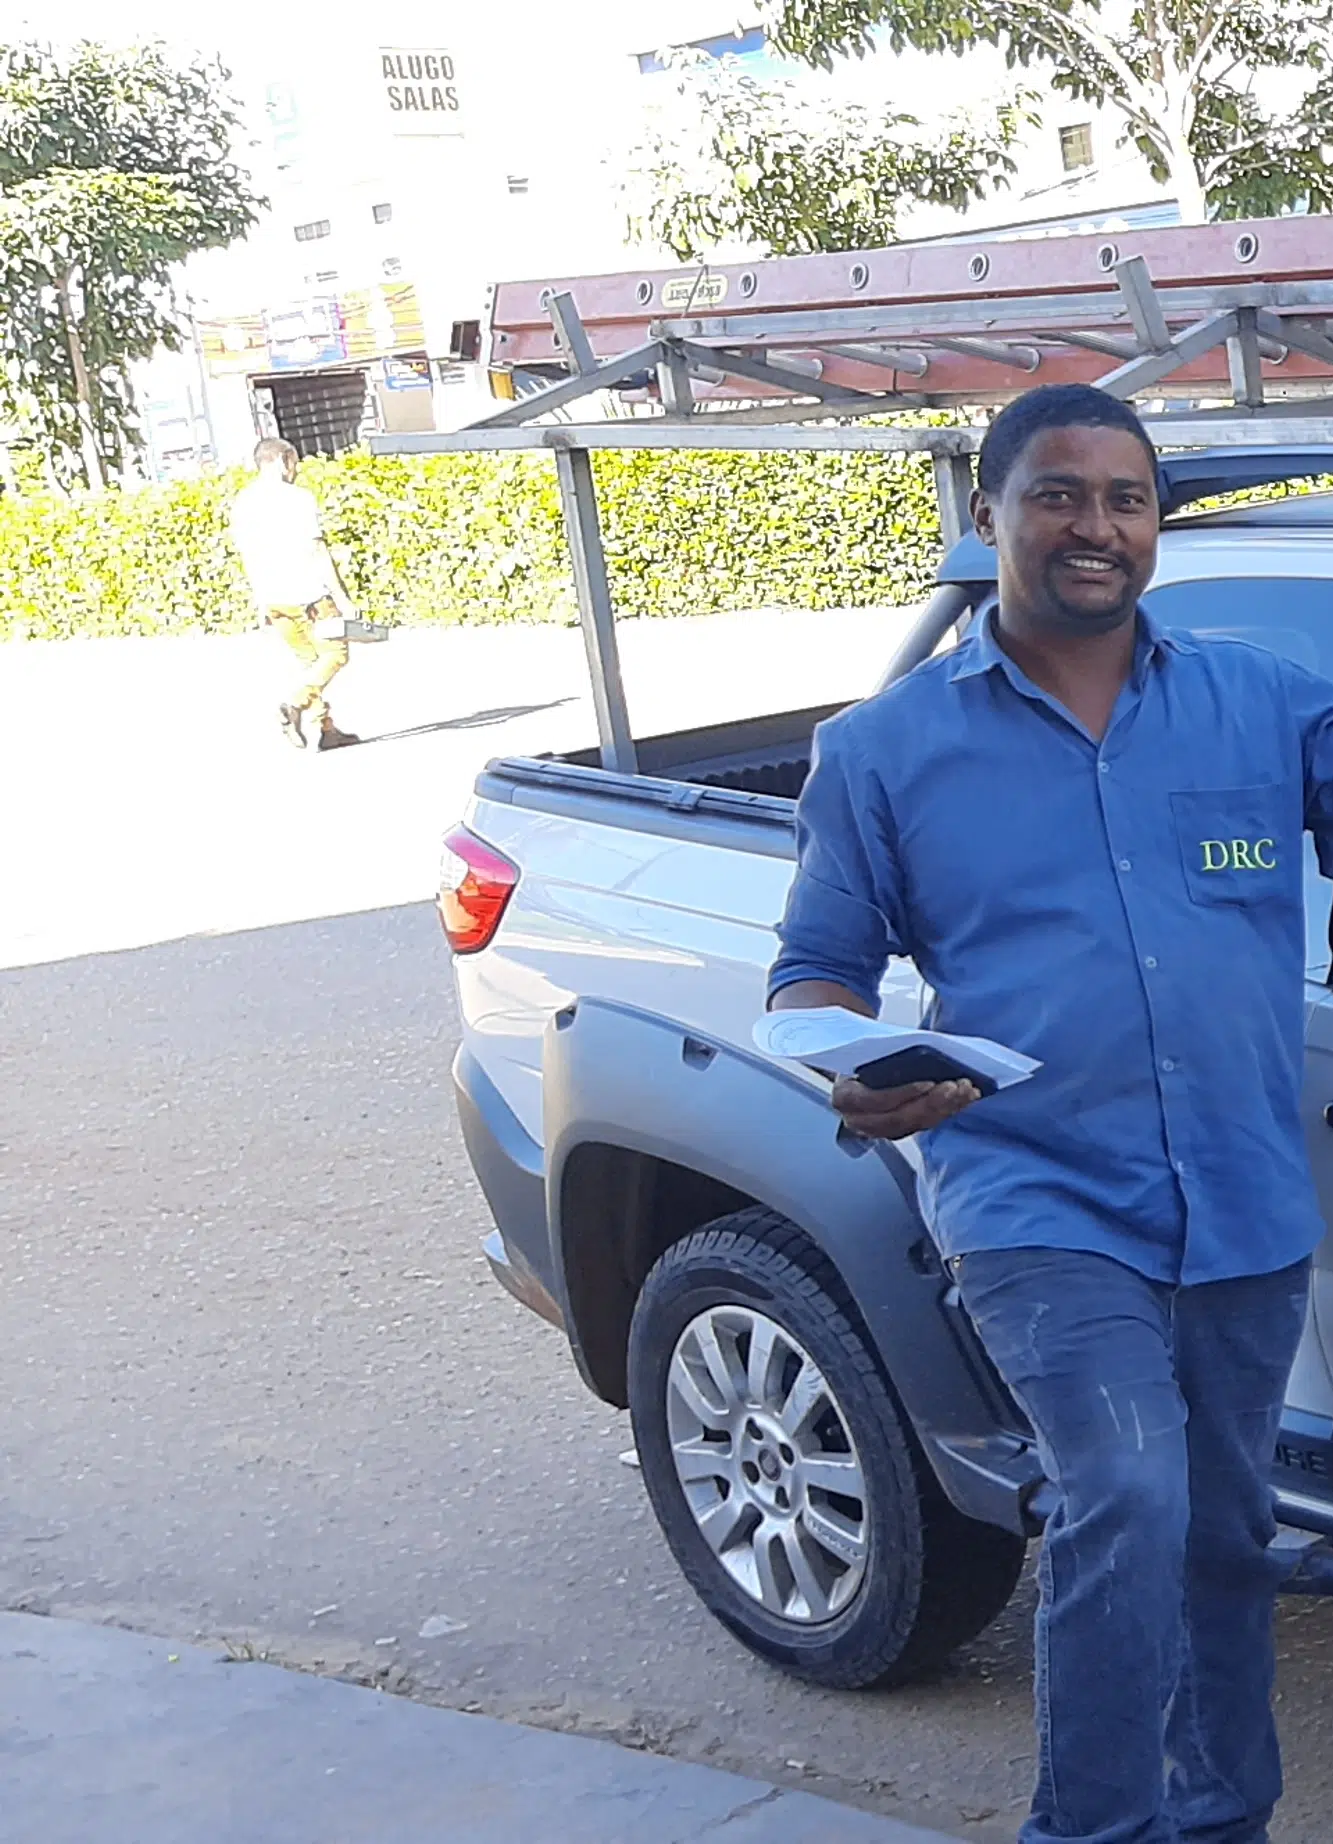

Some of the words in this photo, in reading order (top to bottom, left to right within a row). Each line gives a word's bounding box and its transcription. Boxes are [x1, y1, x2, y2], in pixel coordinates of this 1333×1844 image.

[381, 54, 454, 80] ALUGO
[387, 86, 459, 111] SALAS
[1199, 838, 1276, 872] DRC
